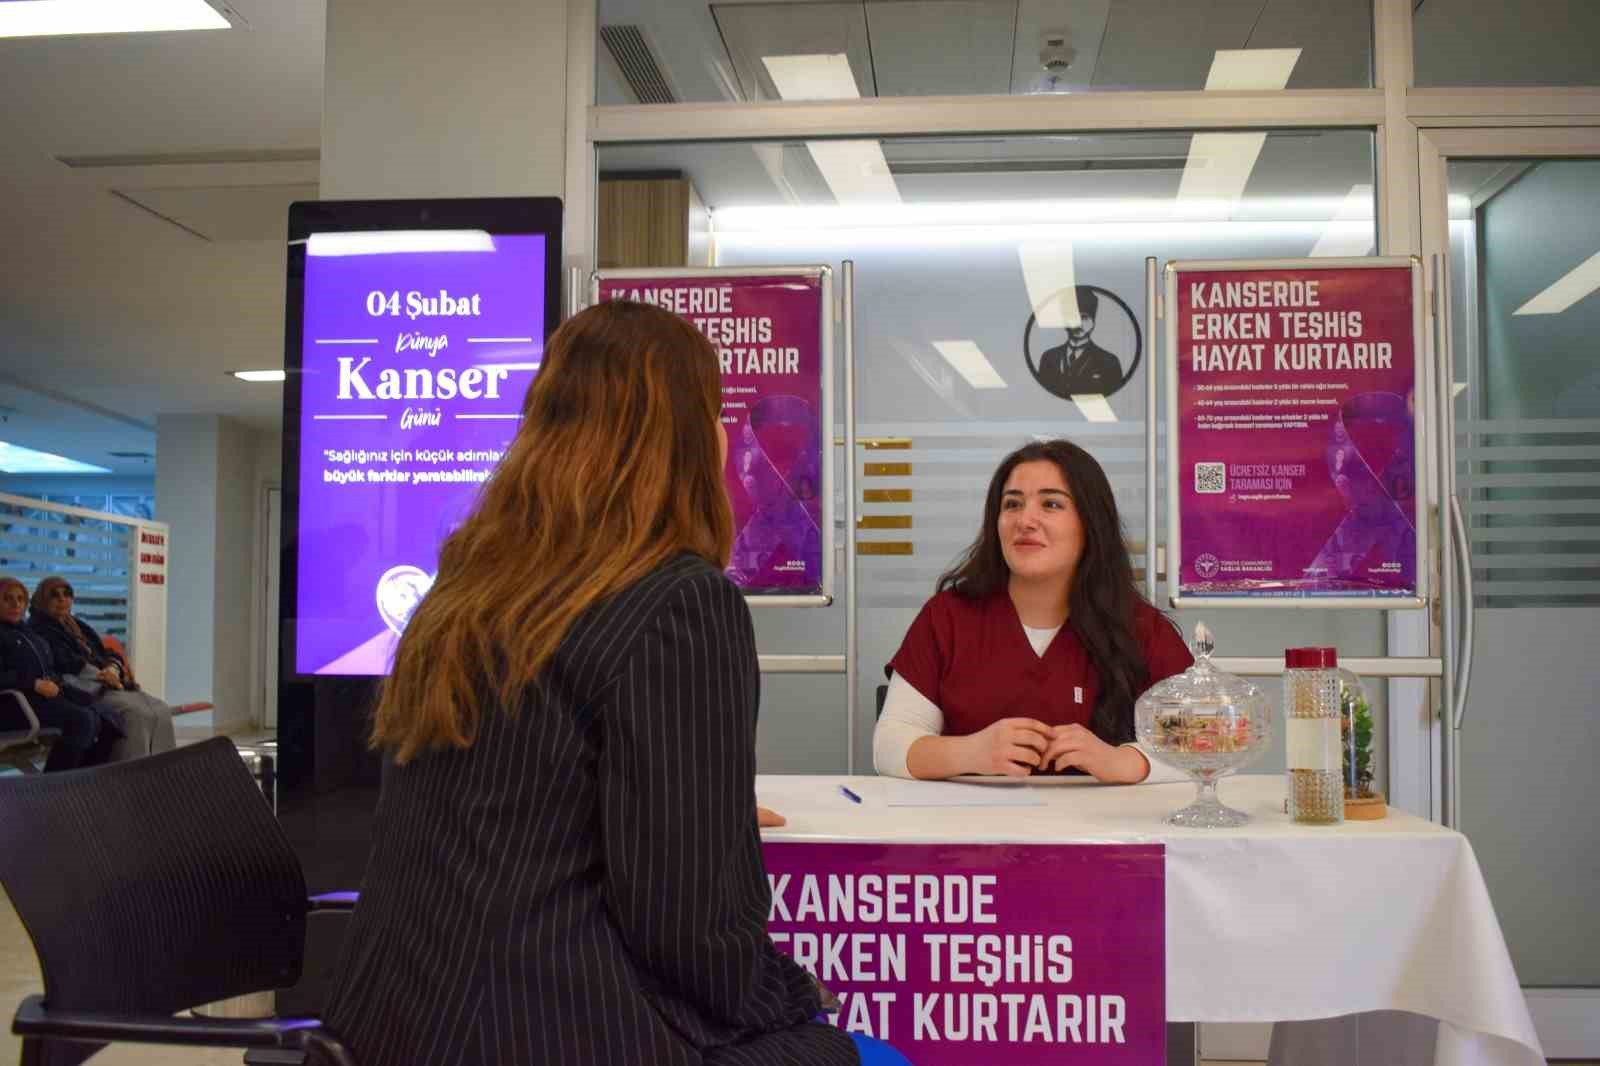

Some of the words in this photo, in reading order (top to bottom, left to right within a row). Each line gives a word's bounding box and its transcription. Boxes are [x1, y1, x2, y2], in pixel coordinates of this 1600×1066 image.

[366, 290, 401, 316] 04
[406, 289, 481, 320] Şubat
[1191, 280, 1320, 309] KANSERDE
[1191, 312, 1271, 341] ERKEN
[395, 332, 448, 357] Dünya
[1192, 344, 1265, 372] HAYAT
[1274, 342, 1393, 371] KURTARIR
[715, 347, 799, 375] RTARIR
[336, 356, 508, 400] Kanser
[400, 407, 441, 430] Günü
[415, 449, 454, 464] küçük
[457, 449, 505, 463] adımla
[323, 469, 365, 485] büyük
[767, 874, 998, 924] KANSERDE
[913, 993, 1127, 1044] KURTARIR
